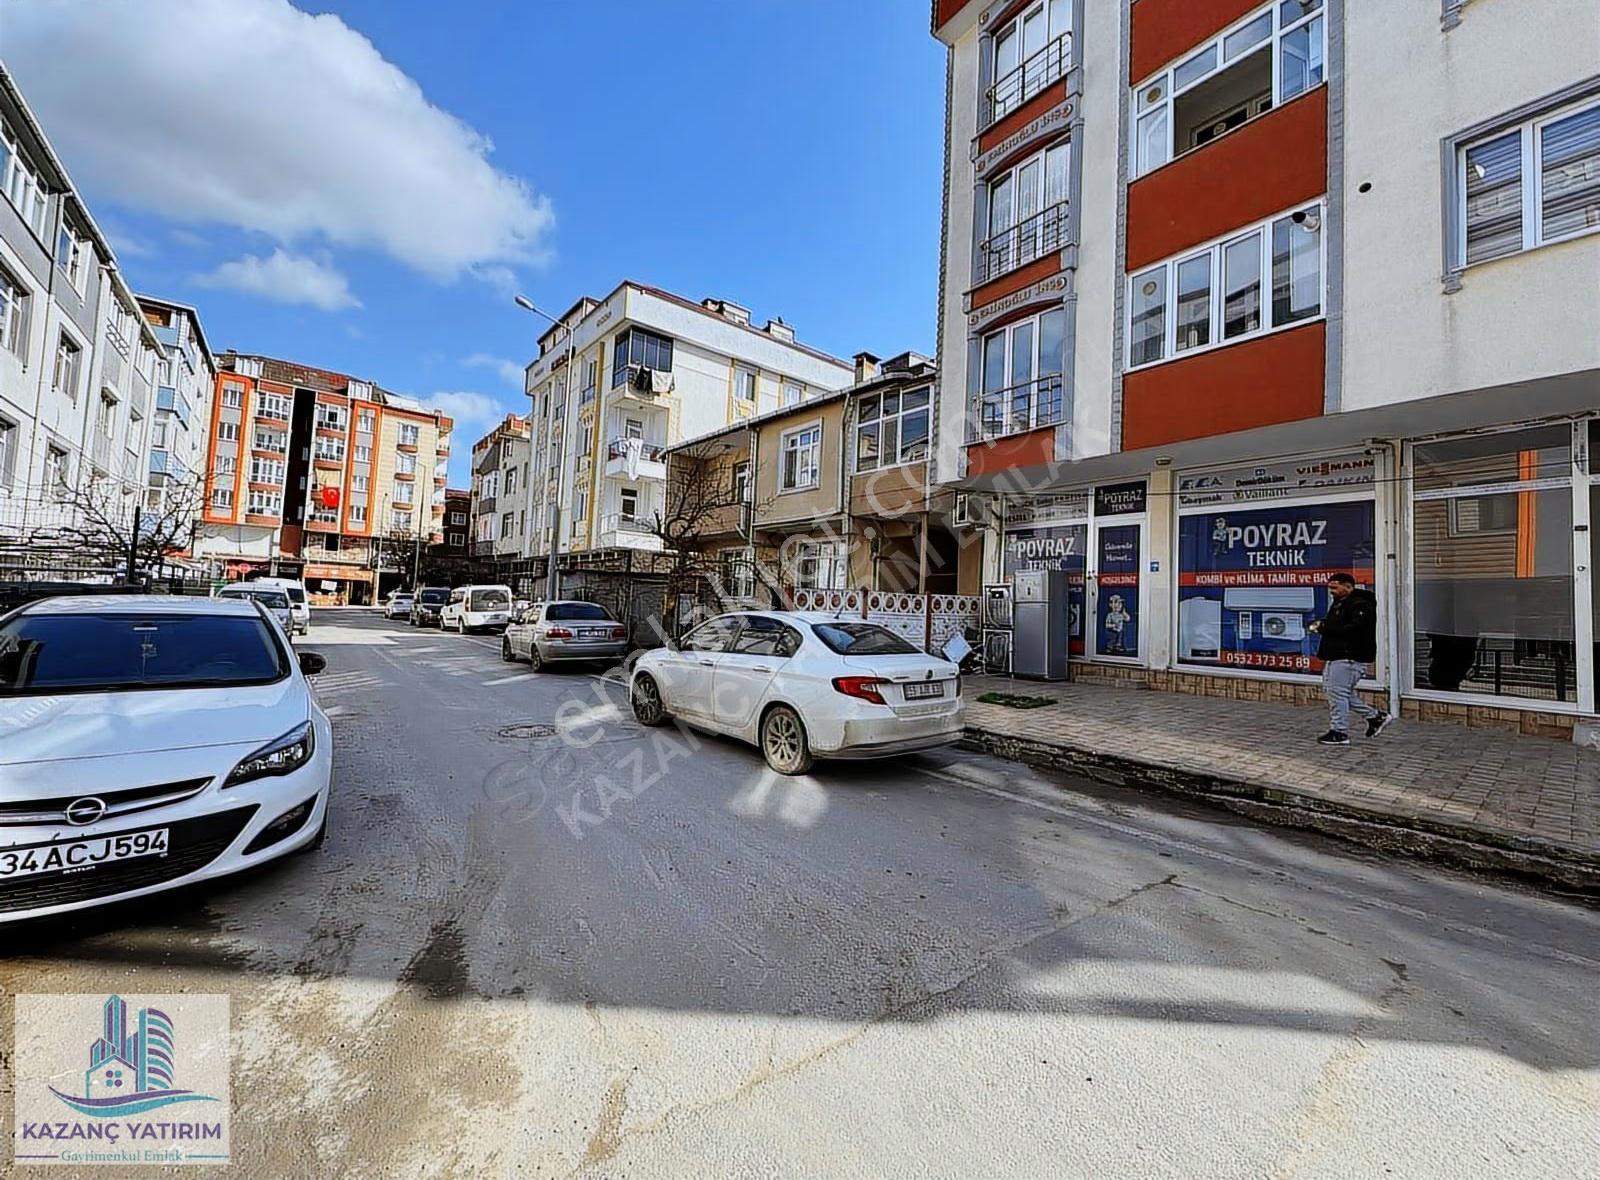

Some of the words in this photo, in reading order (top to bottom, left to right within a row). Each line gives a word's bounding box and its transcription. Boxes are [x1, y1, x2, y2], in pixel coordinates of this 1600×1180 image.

[1104, 490, 1142, 504] POYRAZ
[1228, 521, 1327, 548] POYRAZ
[1017, 537, 1075, 558] POYRAZ
[1247, 550, 1305, 567] TEKNİK
[1196, 573, 1222, 584] KOMBİ
[1224, 576, 1236, 584] ve
[1236, 572, 1264, 584] KLİMA
[1267, 571, 1296, 583] TAMİR
[1299, 574, 1312, 583] ve
[1226, 652, 1253, 664] 0532
[1256, 654, 1275, 666] 373
[1279, 656, 1292, 667] 25
[1296, 656, 1310, 668] 89
